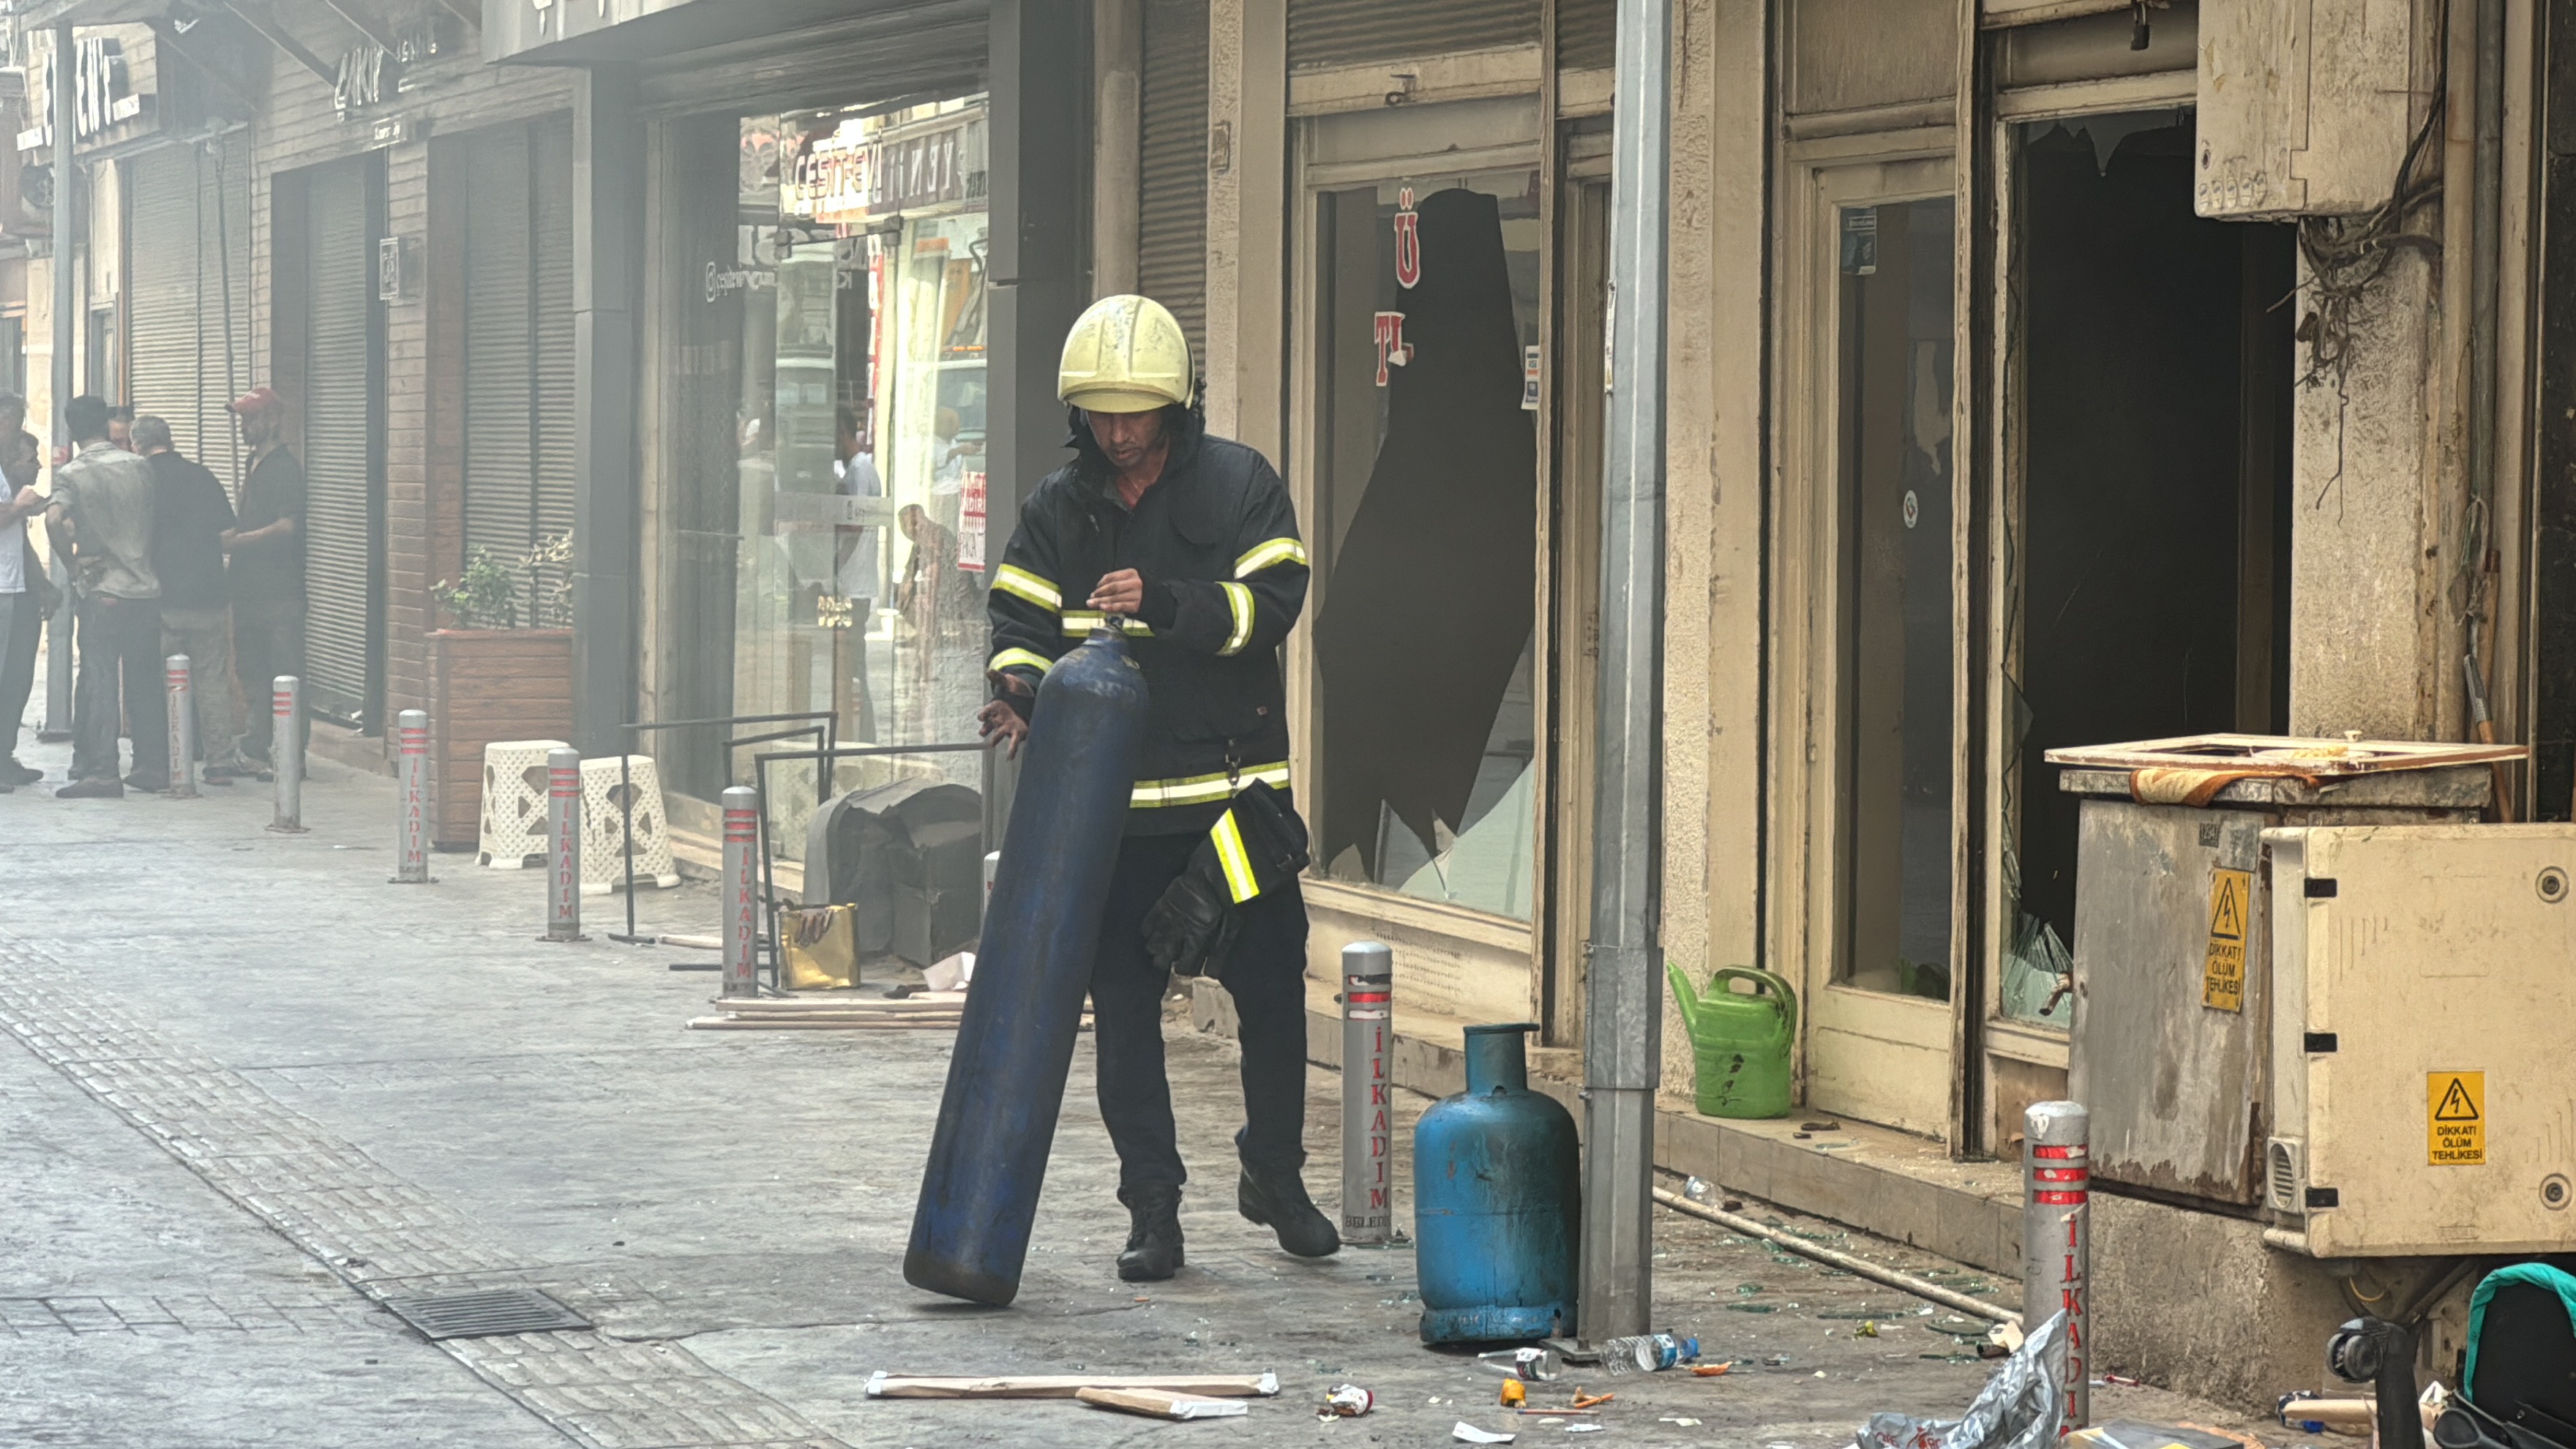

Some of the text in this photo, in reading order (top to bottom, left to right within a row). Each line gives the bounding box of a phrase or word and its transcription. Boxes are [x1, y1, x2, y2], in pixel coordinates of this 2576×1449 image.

[407, 757, 422, 863] İLKADIM
[558, 801, 574, 918] İLKADIM
[736, 846, 752, 978] İLKADIM
[1370, 1027, 1389, 1210] İLKADIM
[2432, 1148, 2483, 1161] TEHLİKESİ
[2442, 1137, 2472, 1148] ÖLÜM
